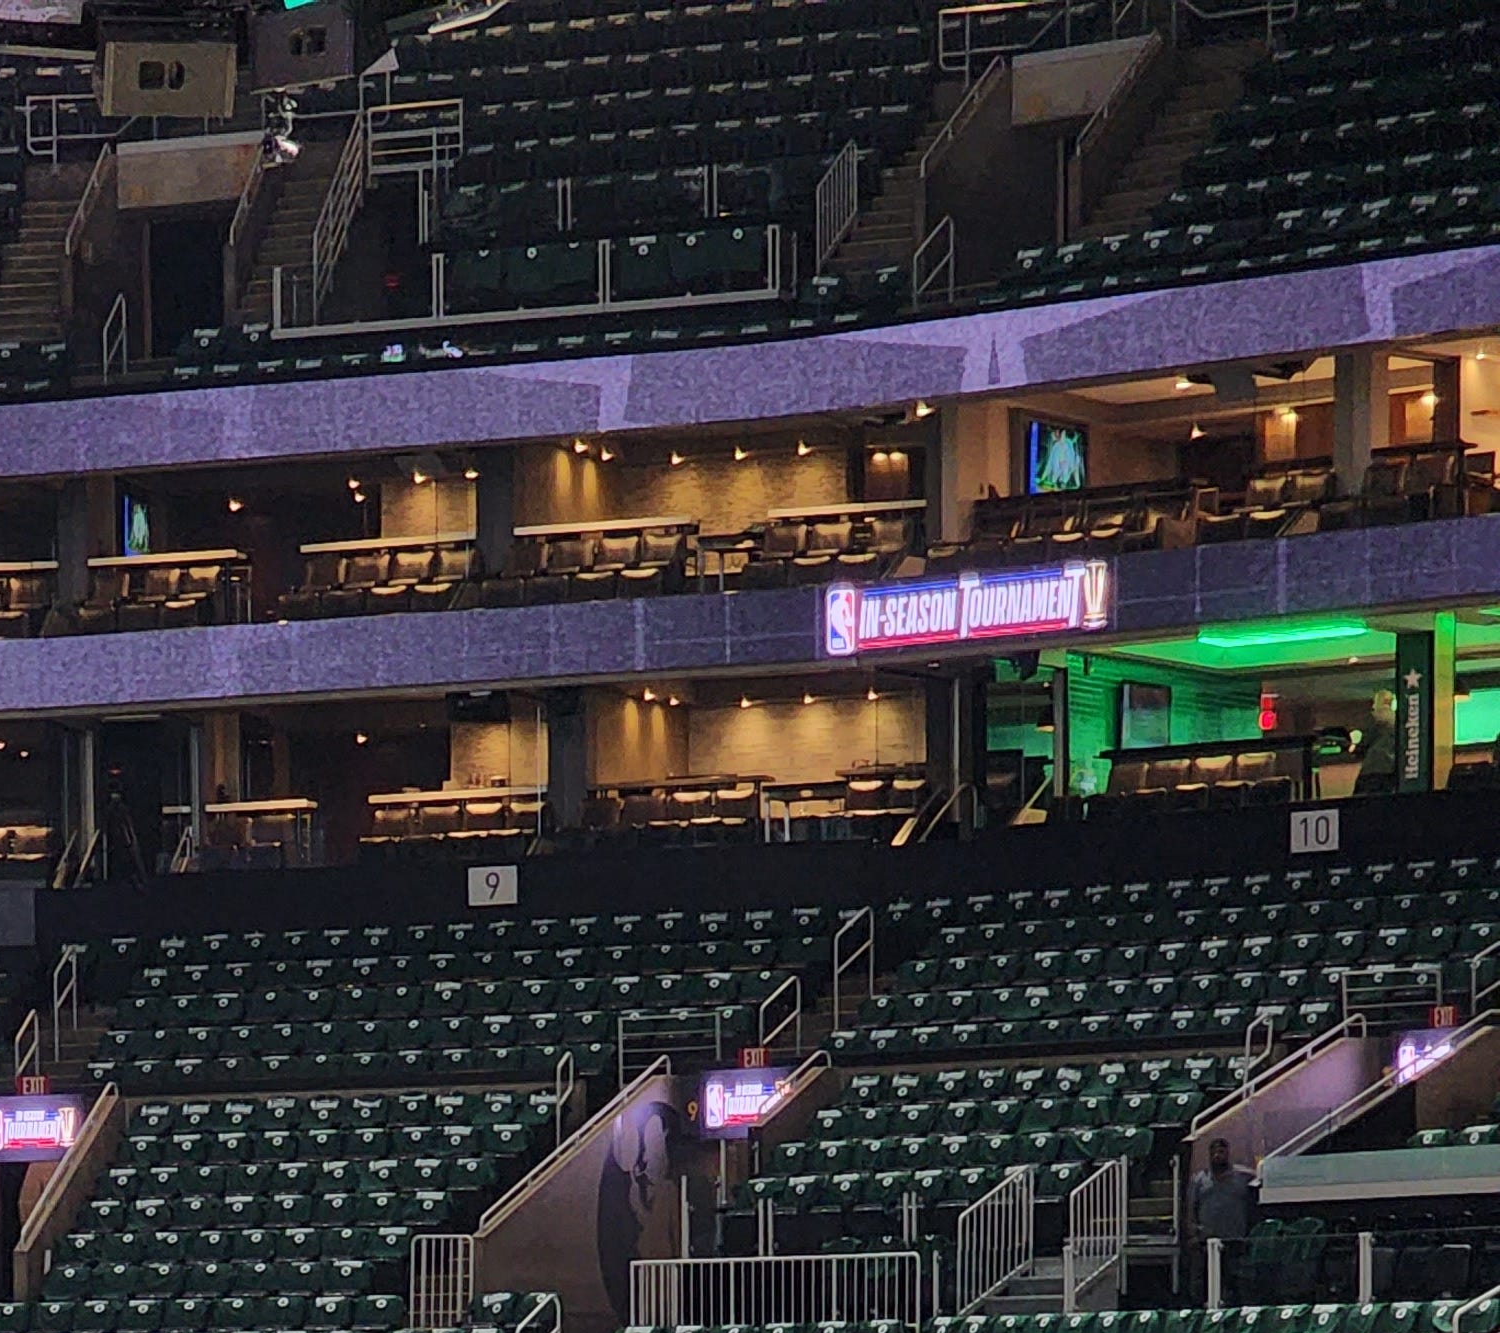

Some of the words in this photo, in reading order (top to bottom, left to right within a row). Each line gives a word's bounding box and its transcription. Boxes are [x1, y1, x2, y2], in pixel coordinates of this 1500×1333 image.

[859, 586, 957, 639] IN-SEASON
[958, 566, 1084, 637] TOURNAMENT
[1404, 693, 1421, 781] Heineken
[1298, 815, 1331, 847] 10
[484, 872, 501, 901] 9
[22, 1076, 45, 1094] EXIT
[687, 1100, 698, 1122] 9
[4, 1115, 62, 1145] TOURNAMENT
